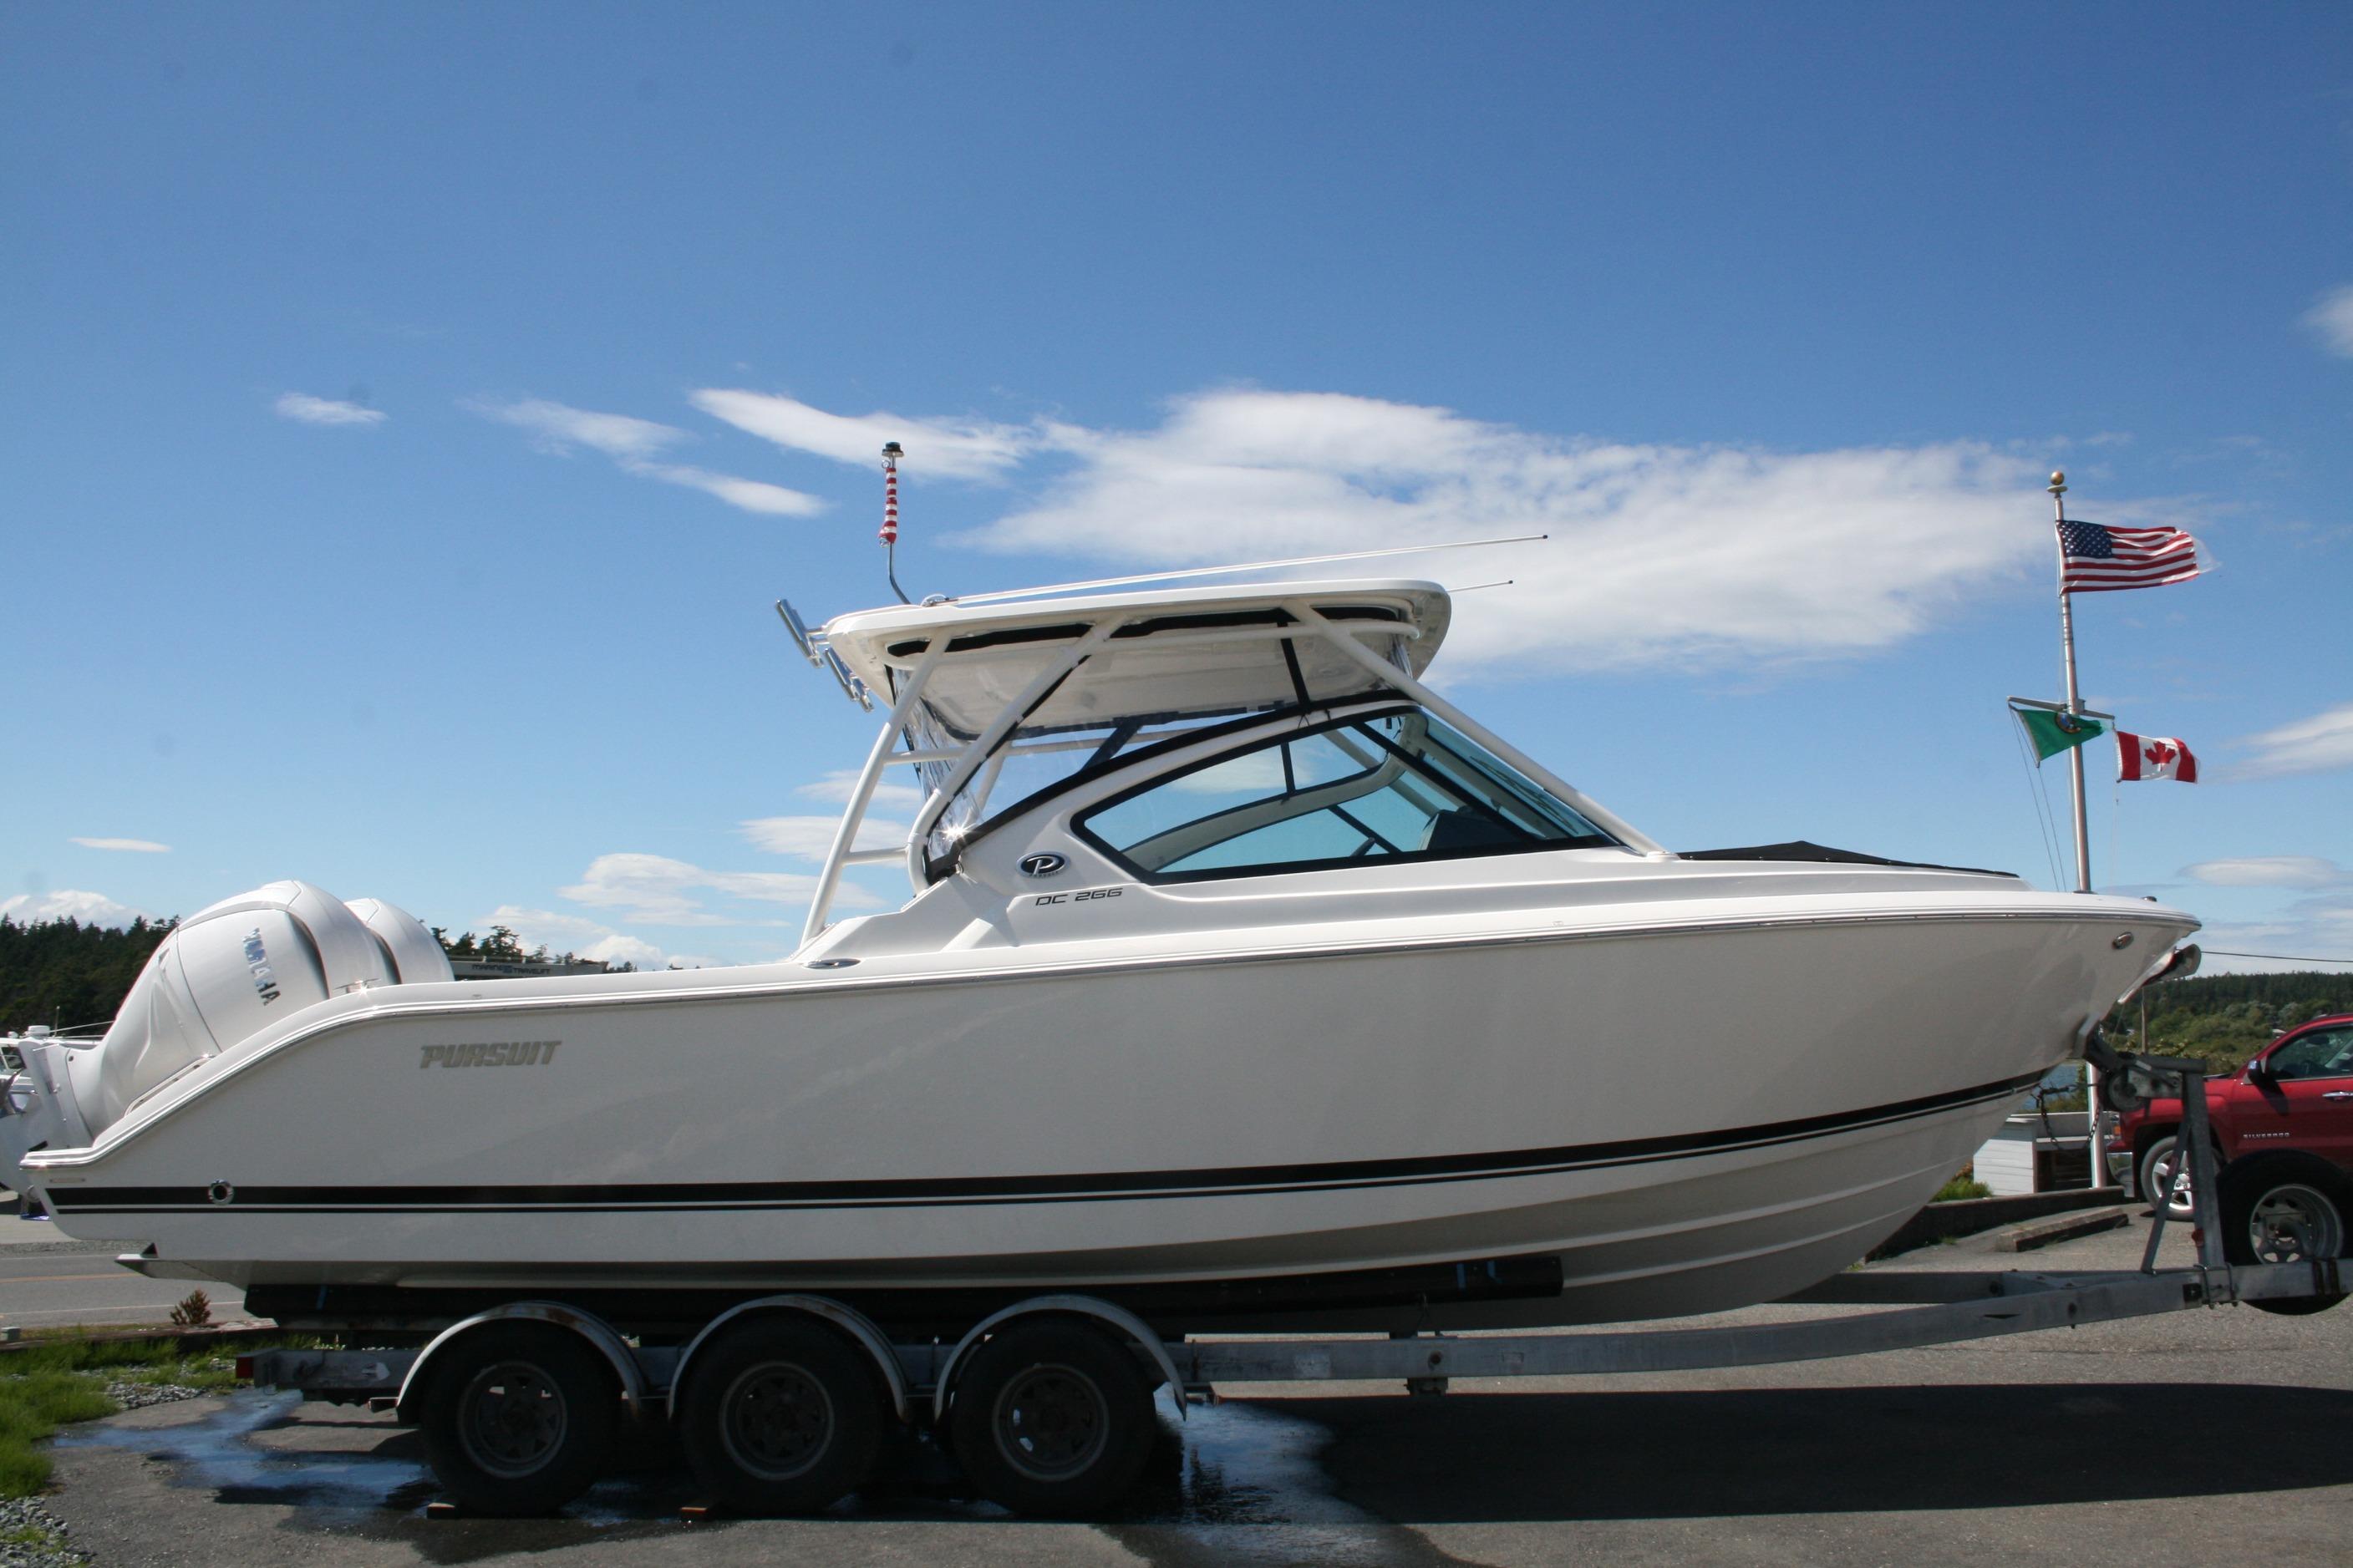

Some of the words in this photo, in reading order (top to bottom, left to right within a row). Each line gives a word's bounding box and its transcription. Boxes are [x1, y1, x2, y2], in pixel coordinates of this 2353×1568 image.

[1035, 894, 1069, 906] DC
[1075, 887, 1123, 901] 266
[241, 927, 282, 1007] YAMAHA
[419, 1040, 562, 1069] PURSUIT
